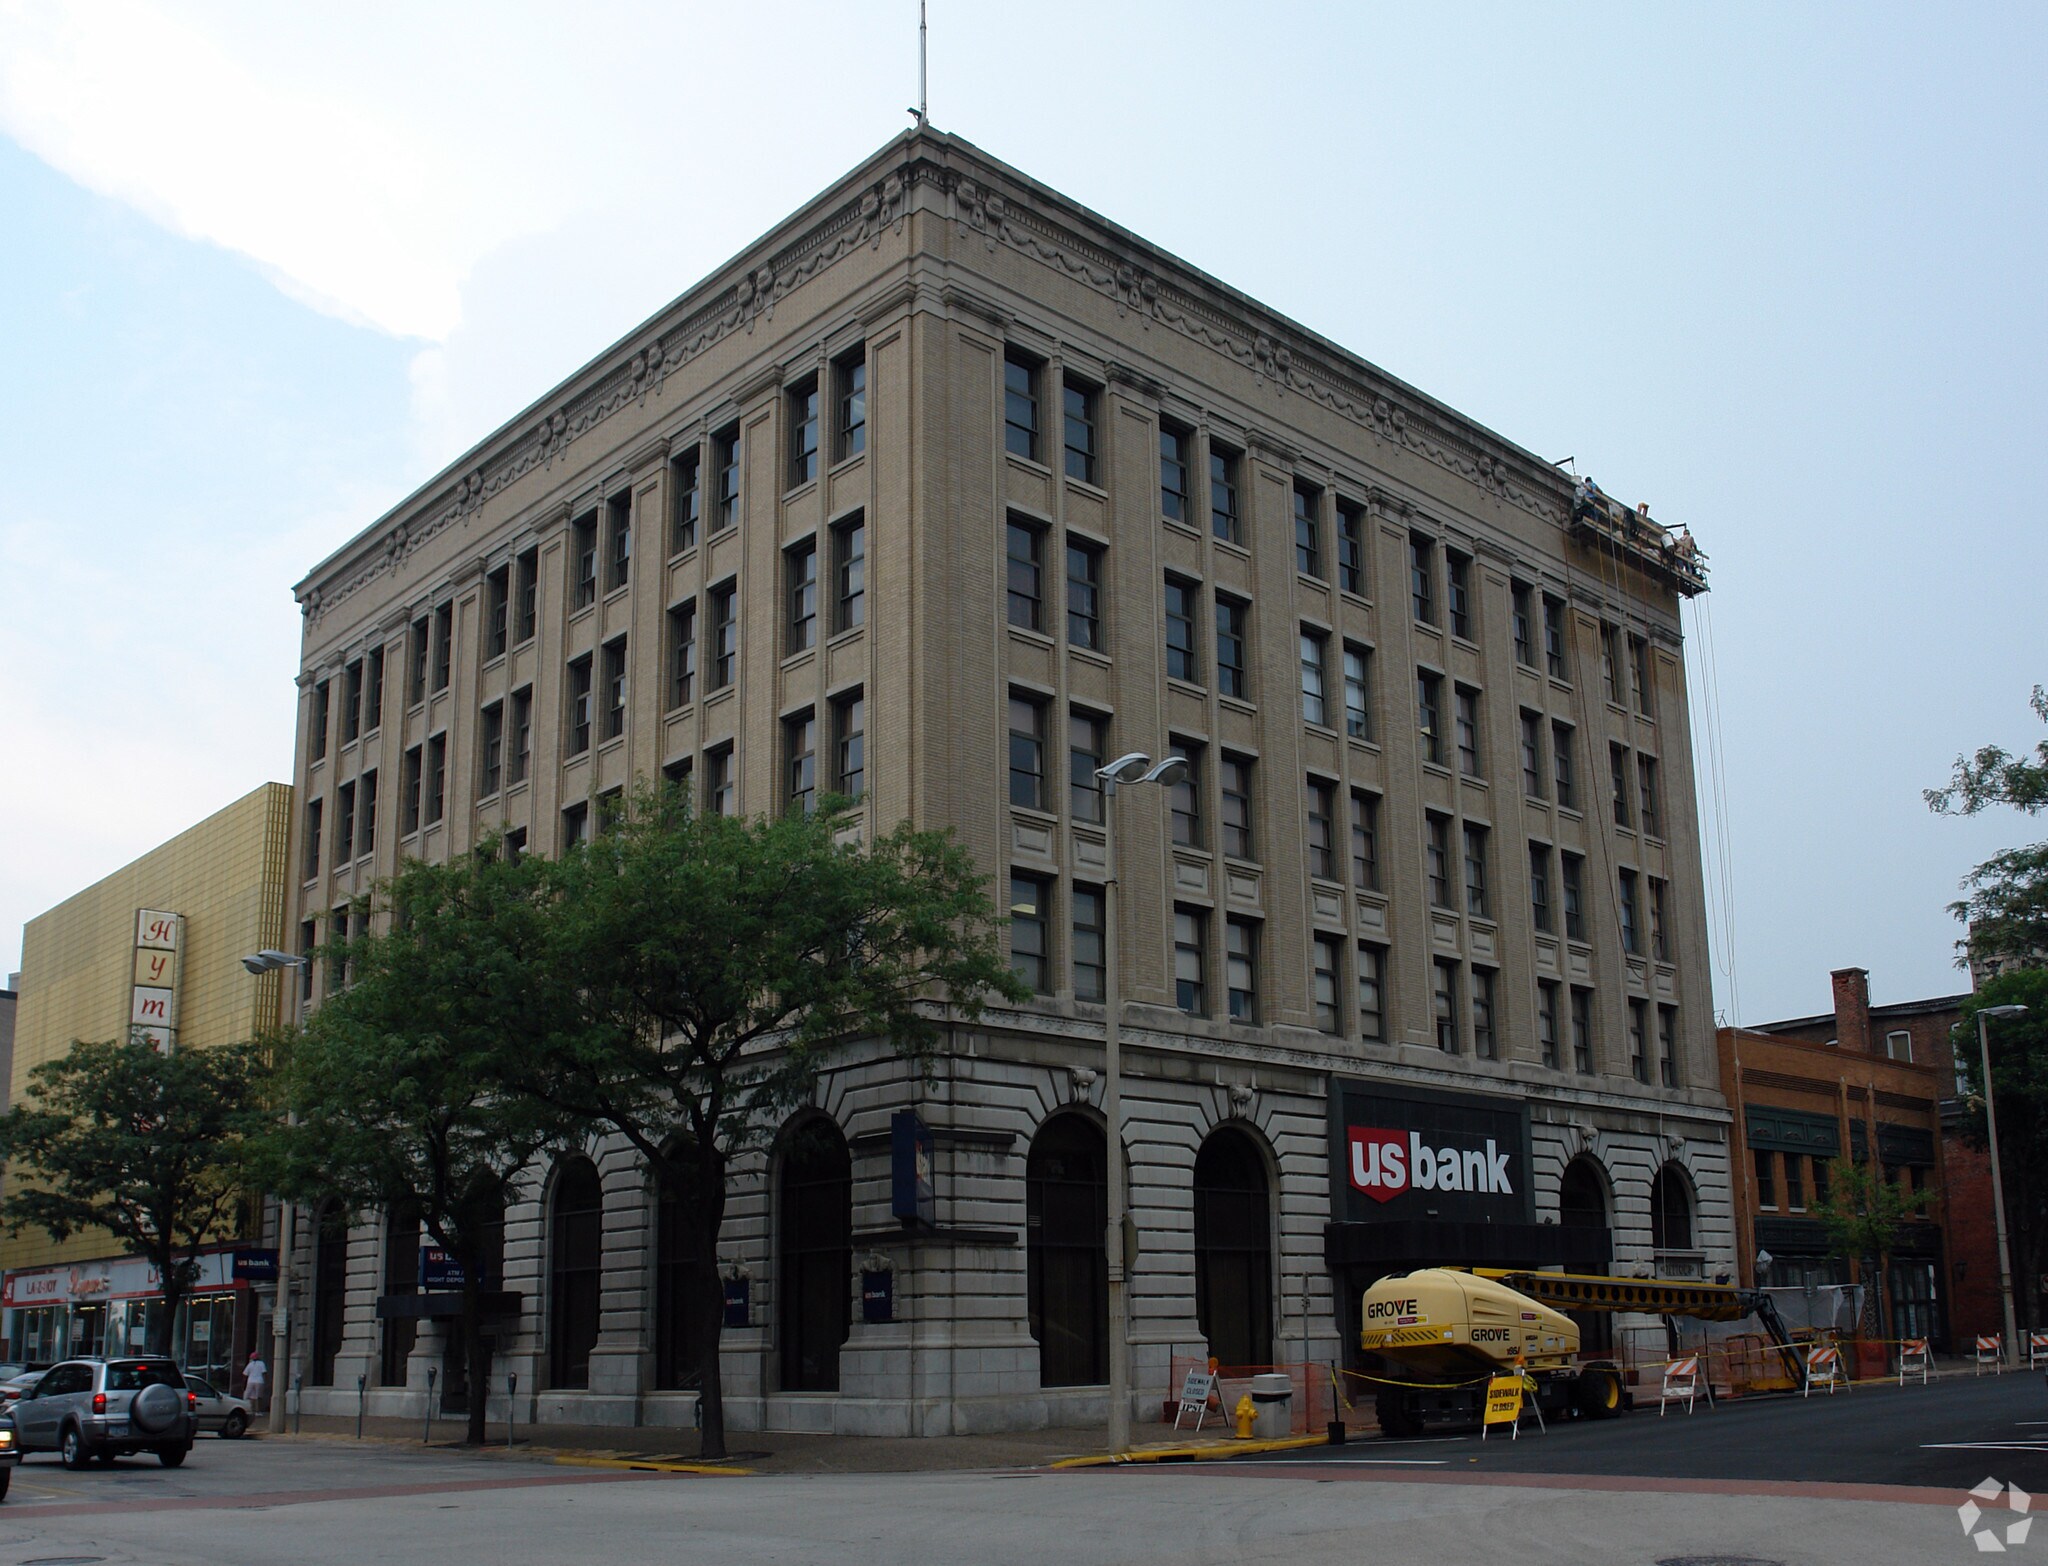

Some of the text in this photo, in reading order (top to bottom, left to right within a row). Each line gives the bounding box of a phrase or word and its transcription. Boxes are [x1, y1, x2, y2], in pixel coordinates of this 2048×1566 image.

[1368, 1300, 1417, 1318] GROVE
[1471, 1328, 1510, 1342] GROVE
[1187, 1377, 1210, 1386] SIDEWALK
[1186, 1387, 1205, 1396] CLOSED
[1489, 1388, 1520, 1399] SIDEWALK
[1492, 1402, 1515, 1412] CLOSED
